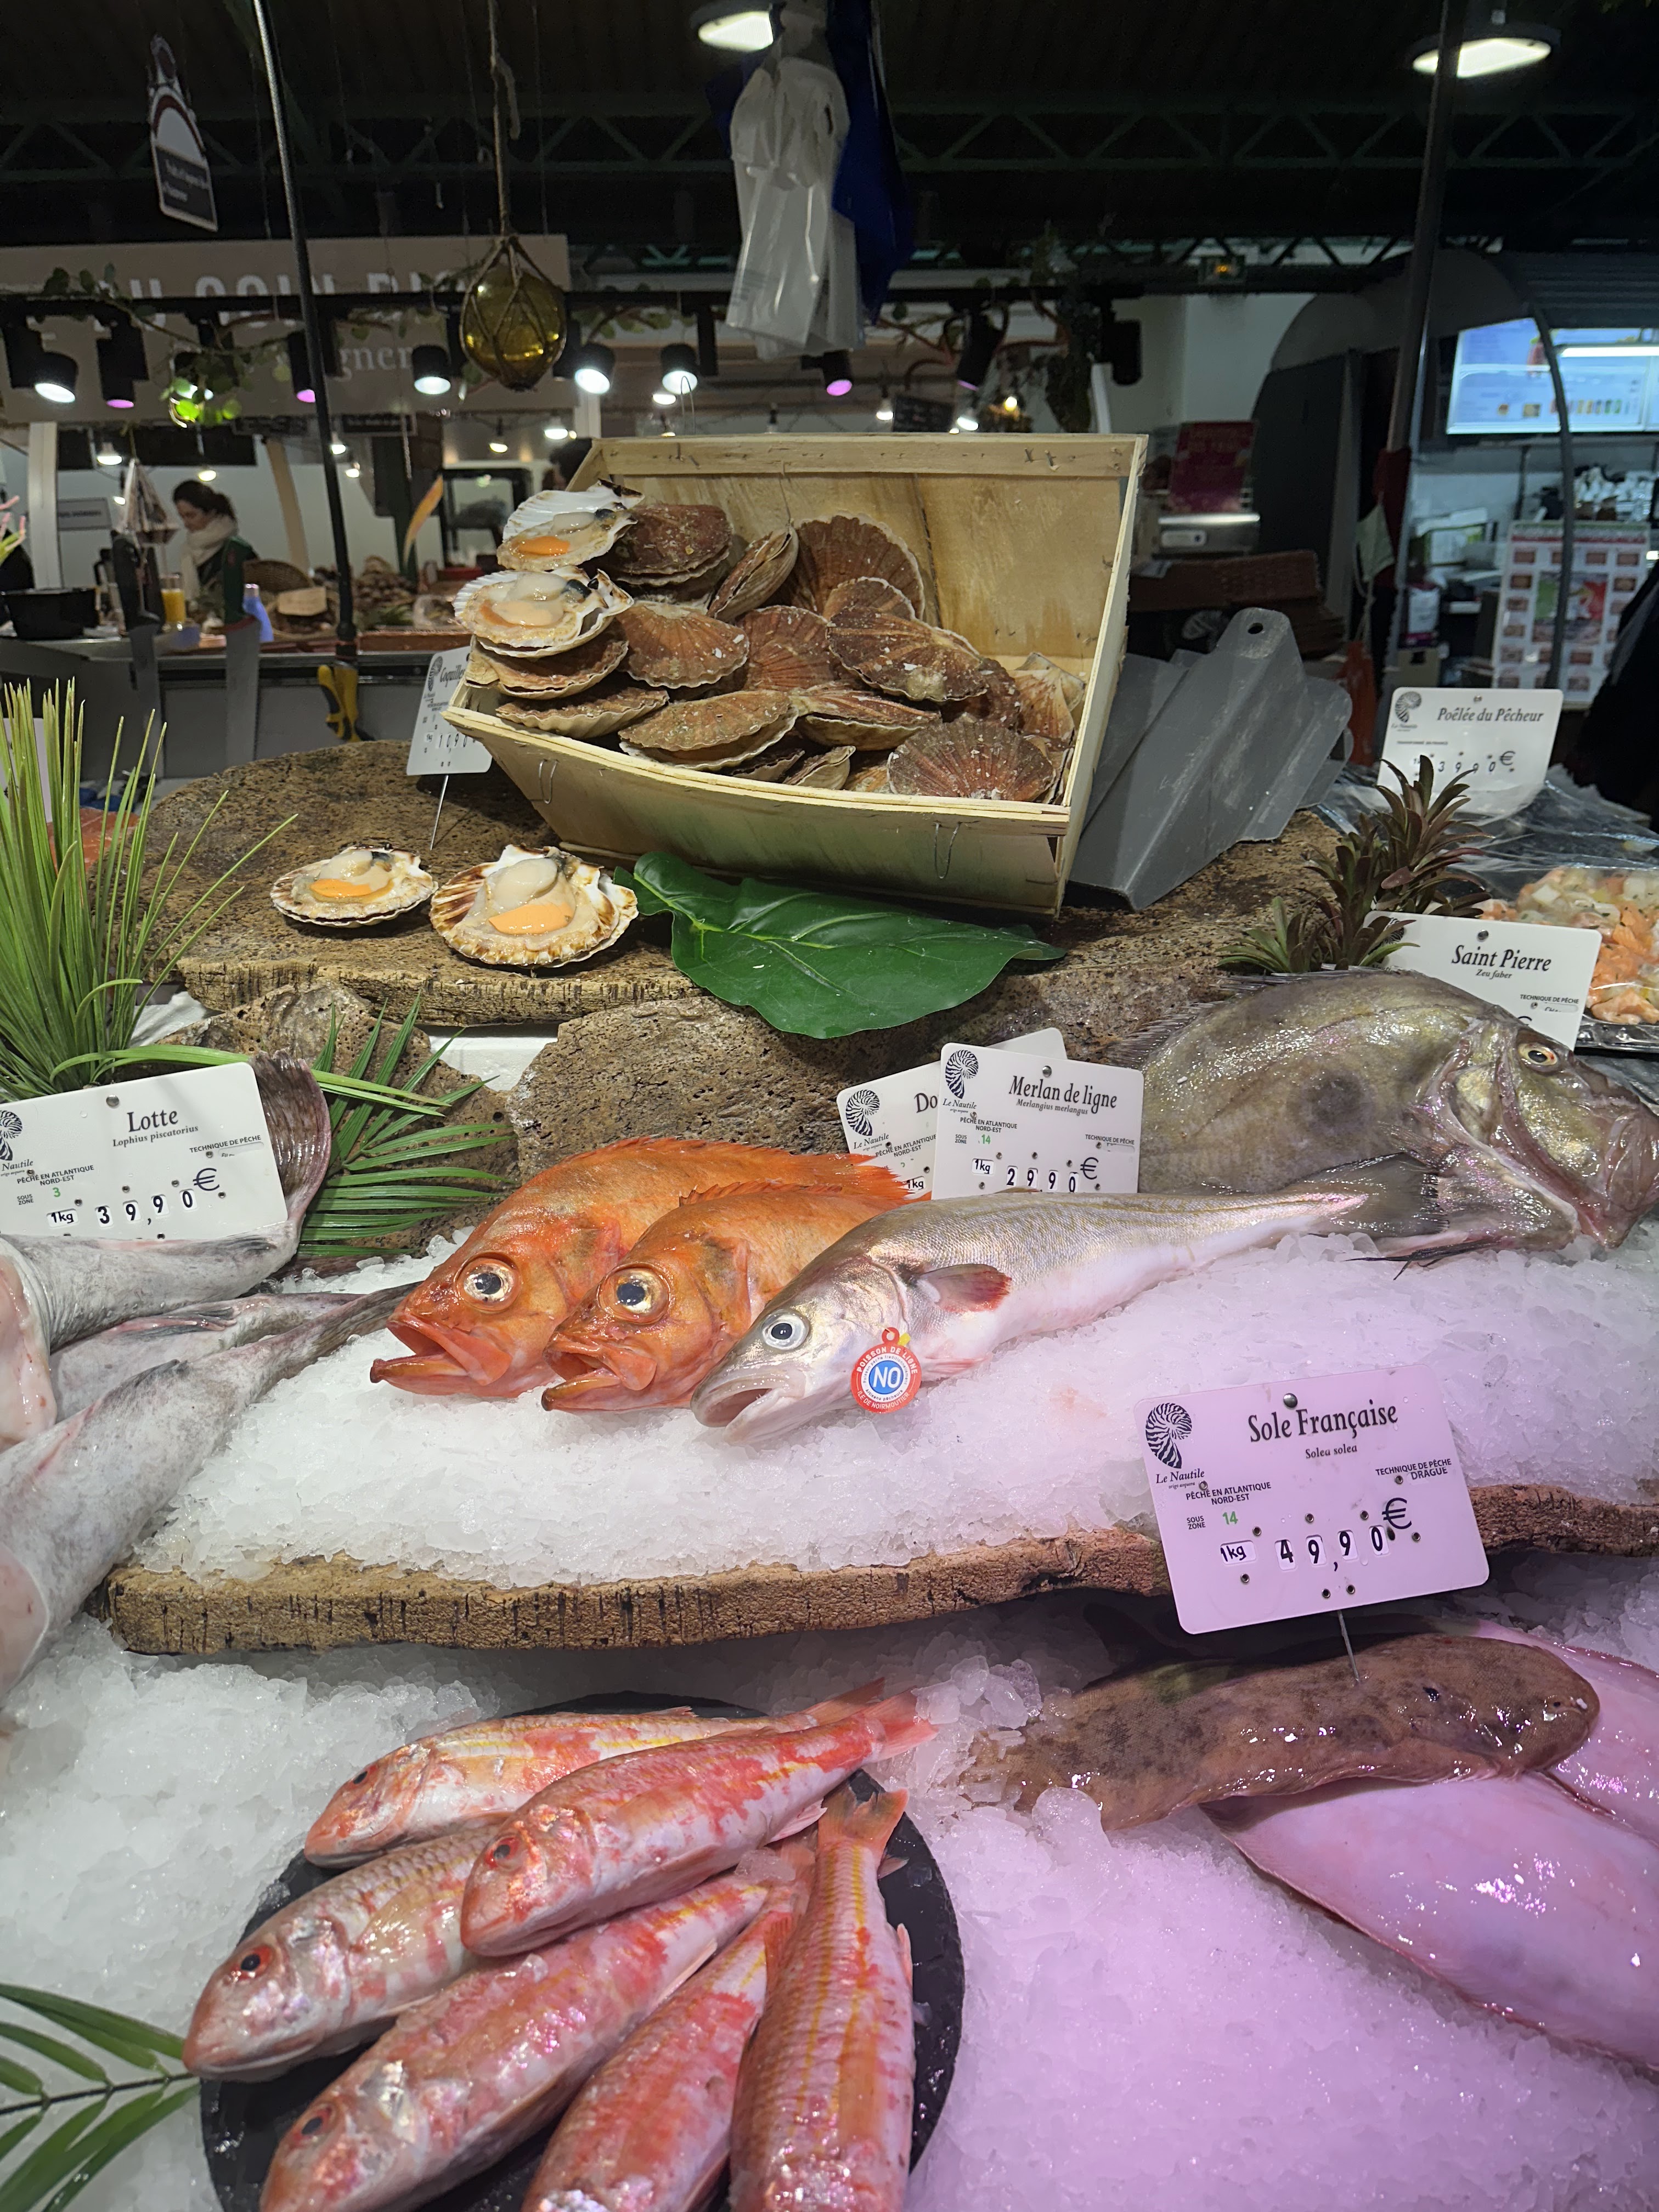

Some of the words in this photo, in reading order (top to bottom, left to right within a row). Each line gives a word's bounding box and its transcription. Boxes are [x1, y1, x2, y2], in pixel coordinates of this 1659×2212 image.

[1437, 707, 1476, 721] Poêlée
[1477, 709, 1493, 721] du
[1495, 708, 1544, 722] Pêcheur
[1500, 751, 1516, 765] €
[1451, 944, 1497, 967] Saint
[1499, 949, 1552, 972] Pierre
[1476, 969, 1489, 977] Zeu
[1489, 969, 1513, 980] faber
[1520, 994, 1550, 1002] TECHNIQUE
[1009, 1075, 1060, 1101] Merlan
[1064, 1083, 1080, 1103] de
[1083, 1085, 1118, 1114] ligne
[952, 1100, 977, 1109] Nautile
[1017, 1098, 1053, 1111] Merlangius
[1054, 1105, 1088, 1116] merlangus
[127, 1110, 178, 1132] Lotte
[985, 1120, 1017, 1129] ATLANTIQUE
[112, 1134, 148, 1148] Lophius
[150, 1125, 199, 1142] piscatorius
[863, 1133, 890, 1147] Nautile
[981, 1134, 991, 1145] 14
[1085, 1134, 1112, 1143] TECHNIQUE
[189, 1141, 228, 1154] TECHNIQUE
[240, 1135, 262, 1144] PÊCHE
[894, 1145, 922, 1158] NORD-EST
[2, 1159, 33, 1171] Nautile
[974, 1159, 991, 1175] 1kg
[1080, 1156, 1099, 1180] €
[17, 1174, 40, 1184] PÊCHÉ
[52, 1165, 94, 1178] ATLANTIQUE
[40, 1175, 75, 1186] NORD-EST
[51, 1211, 75, 1224] 1kg
[193, 1167, 220, 1191] €
[52, 1187, 61, 1198] 3
[856, 1346, 887, 1373] POISSON
[890, 1346, 901, 1355] DE
[902, 1350, 918, 1374] LIGNE
[873, 1366, 901, 1389] NO
[864, 1398, 871, 1406] DE
[871, 1392, 910, 1410] NOIRMOUTIER
[1248, 1412, 1293, 1443] Sole
[1296, 1398, 1398, 1438] Française
[1306, 1448, 1330, 1459] Solea
[1334, 1444, 1358, 1455] solea
[1375, 1463, 1417, 1476] TECHNIQUE
[1429, 1458, 1452, 1469] PÊCHE
[1411, 1467, 1448, 1480] DRAGUE
[1155, 1474, 1168, 1484] Le
[1170, 1469, 1205, 1482] Nautile
[1186, 1488, 1211, 1500] PÊCHÉ
[1224, 1482, 1272, 1494] ATLANTIQUE
[1211, 1493, 1250, 1505] NORD-EST
[1222, 1511, 1239, 1525] 14
[1188, 1522, 1206, 1530] ZONE
[1220, 1545, 1247, 1562] 1kg
[1381, 1497, 1412, 1530] €
